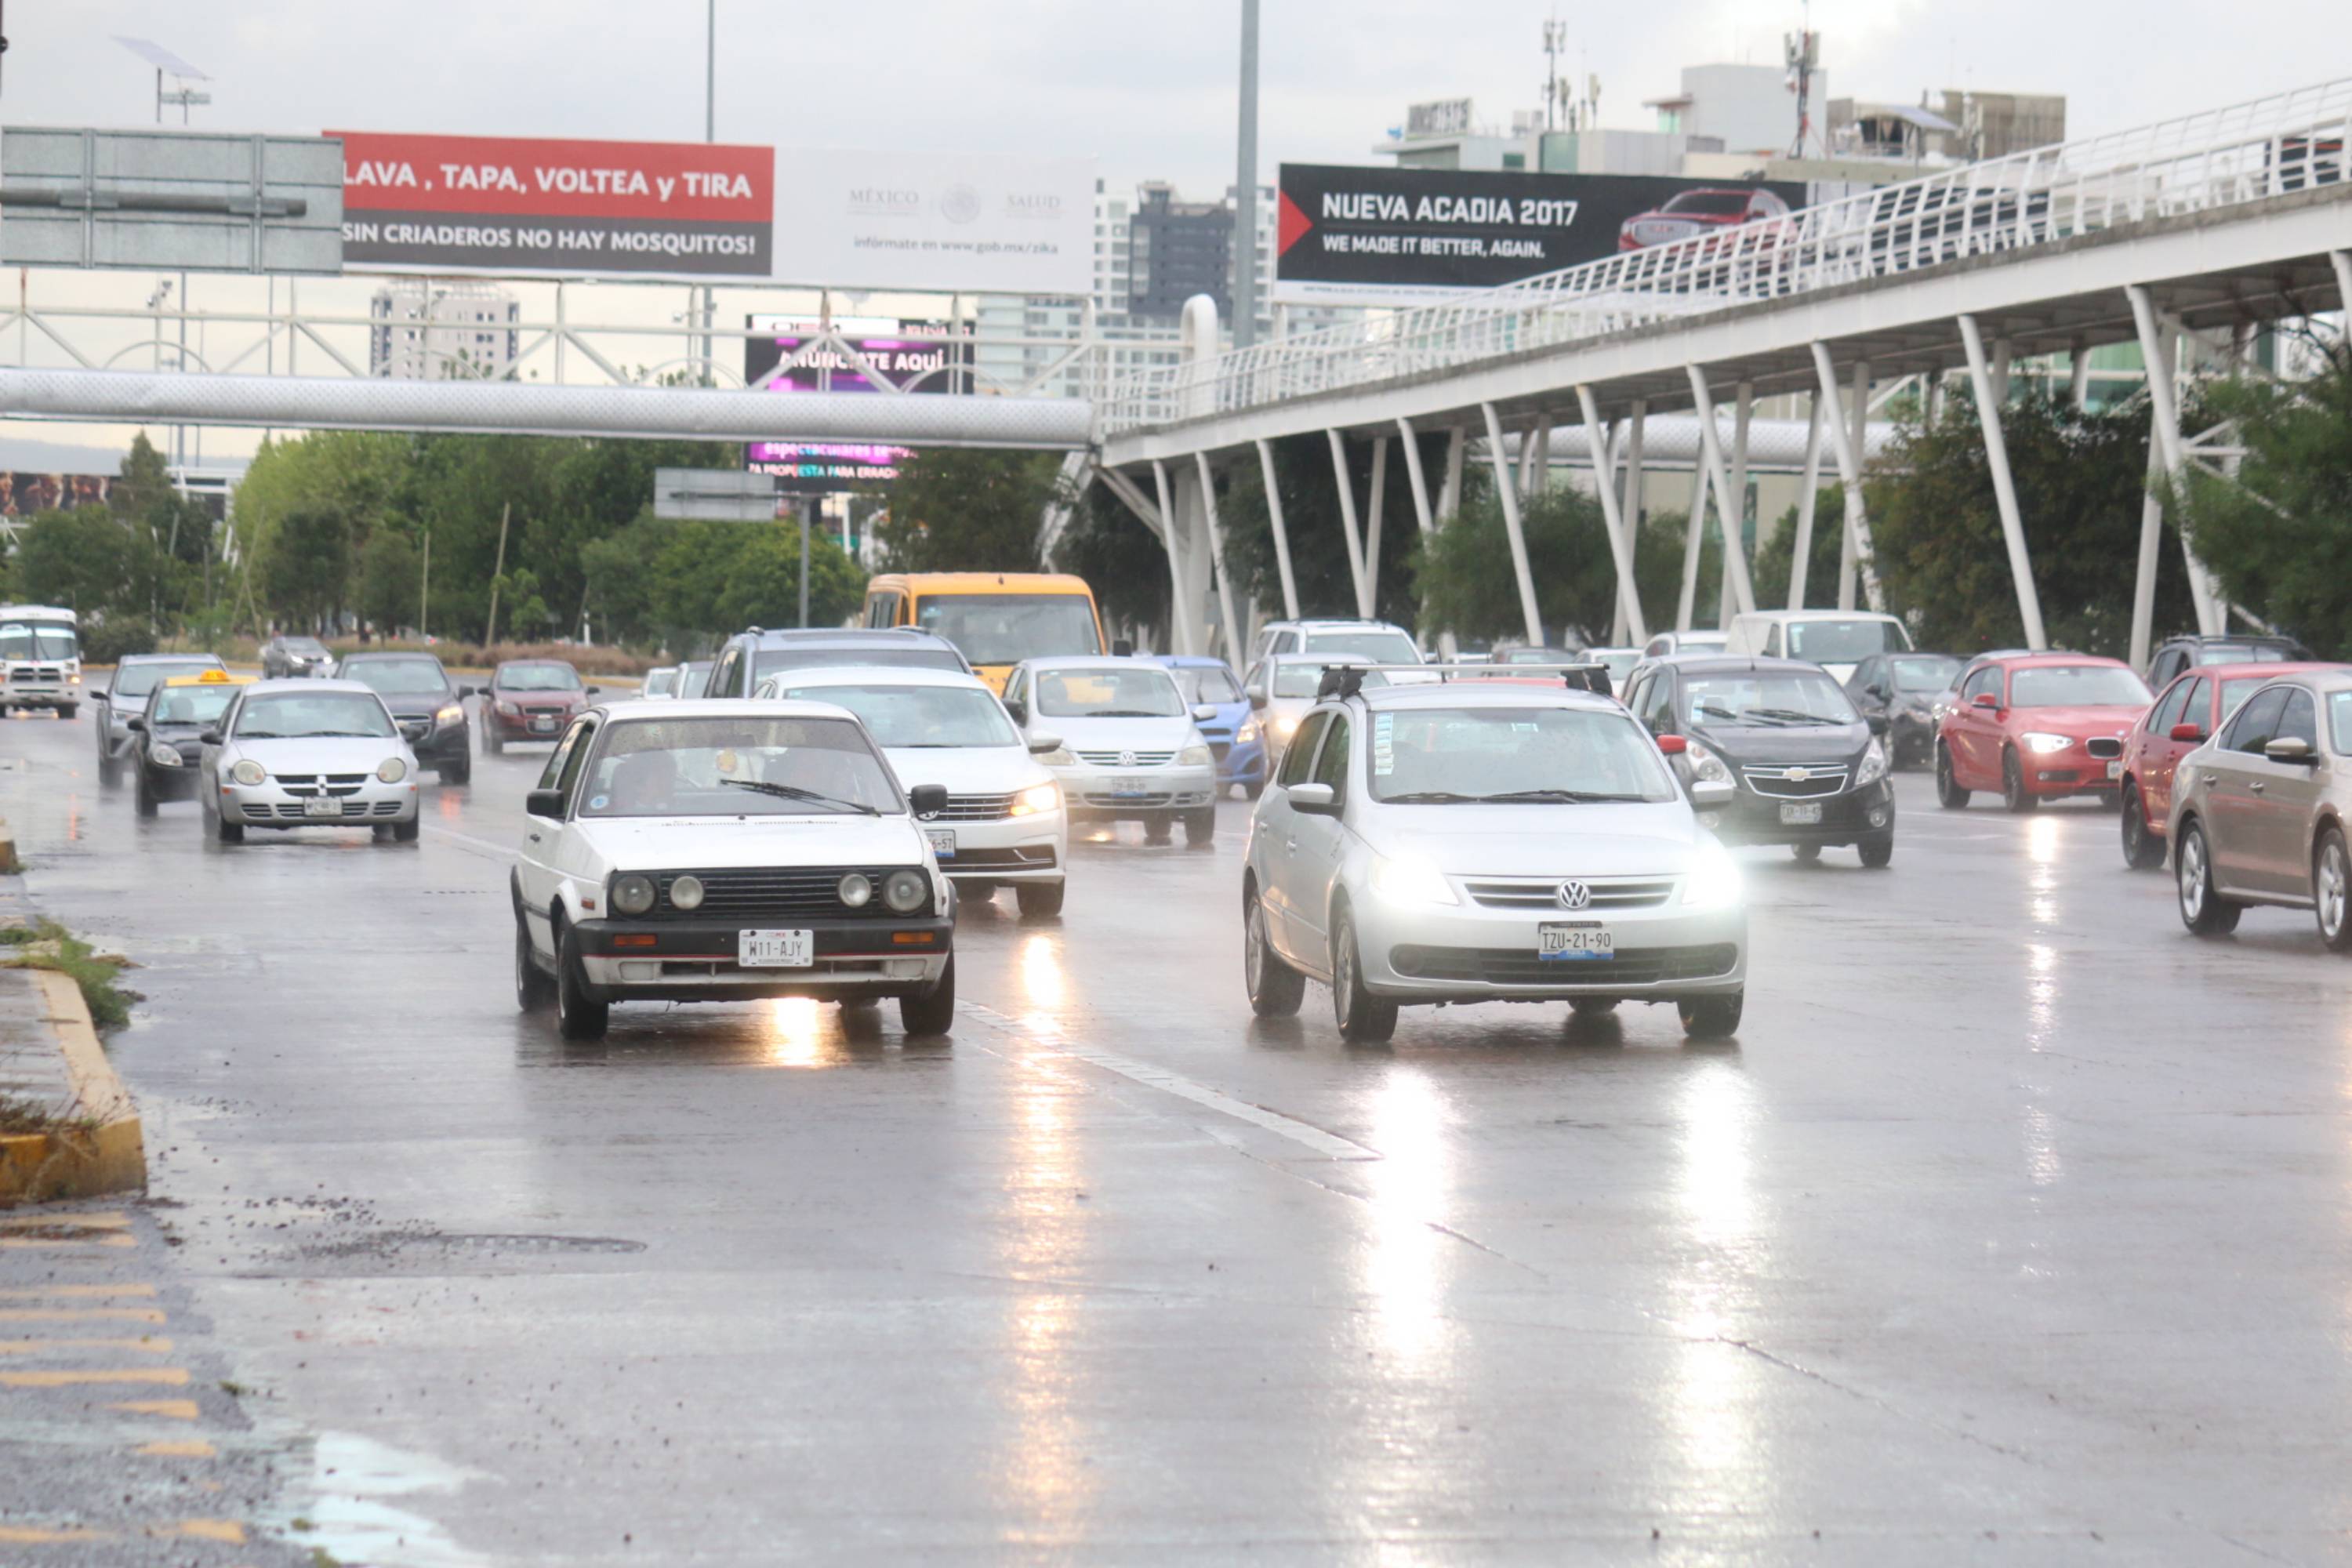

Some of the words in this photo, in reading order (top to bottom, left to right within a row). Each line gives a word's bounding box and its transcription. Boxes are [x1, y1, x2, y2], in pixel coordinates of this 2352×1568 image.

[343, 160, 417, 187] LAVA
[440, 163, 528, 194] TAPA,
[534, 166, 650, 196] VOLTEA
[655, 176, 675, 202] y
[681, 171, 753, 199] TIRA
[1323, 192, 1410, 221] NUEVA
[1415, 196, 1515, 224] ACADIA
[1519, 199, 1578, 226] 2017
[343, 222, 379, 242] SIN
[383, 223, 512, 248] CRIADEROS
[517, 229, 552, 249] NO
[557, 230, 605, 250] HAY
[611, 231, 756, 256] MOSQUITOS!
[1323, 234, 1349, 252] WE
[1352, 235, 1399, 254] MADE
[1403, 237, 1417, 254] IT
[1420, 238, 1487, 258] BETTER,
[1490, 240, 1546, 259] AGAIN.
[779, 347, 890, 371] ANÚNCTE
[894, 348, 944, 371] AQUÍ
[749, 940, 803, 957] W11-AJY
[1541, 932, 1612, 949] TZU-21-90
